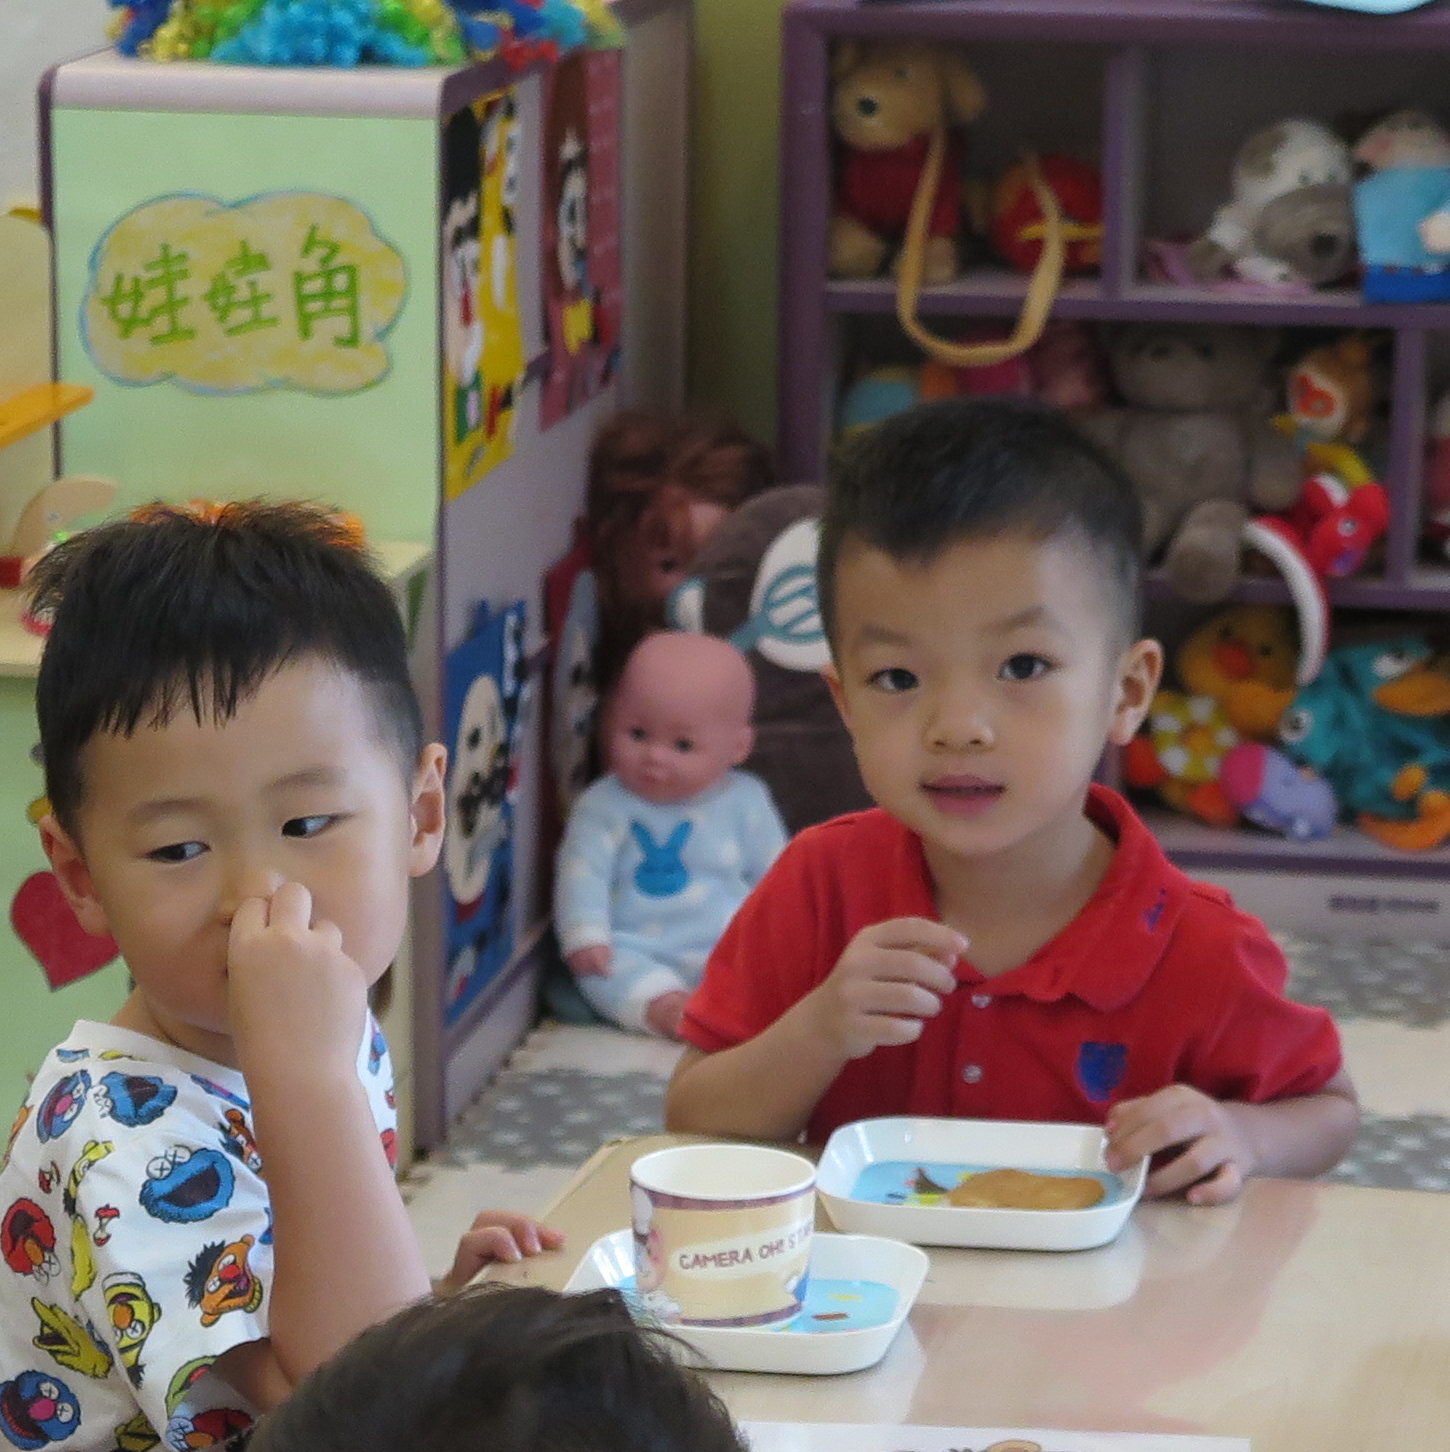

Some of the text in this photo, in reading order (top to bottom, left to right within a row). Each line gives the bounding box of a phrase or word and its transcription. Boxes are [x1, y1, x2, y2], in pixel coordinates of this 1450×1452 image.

[100, 223, 360, 348] 娃娃角
[679, 1247, 753, 1270] CAMERA
